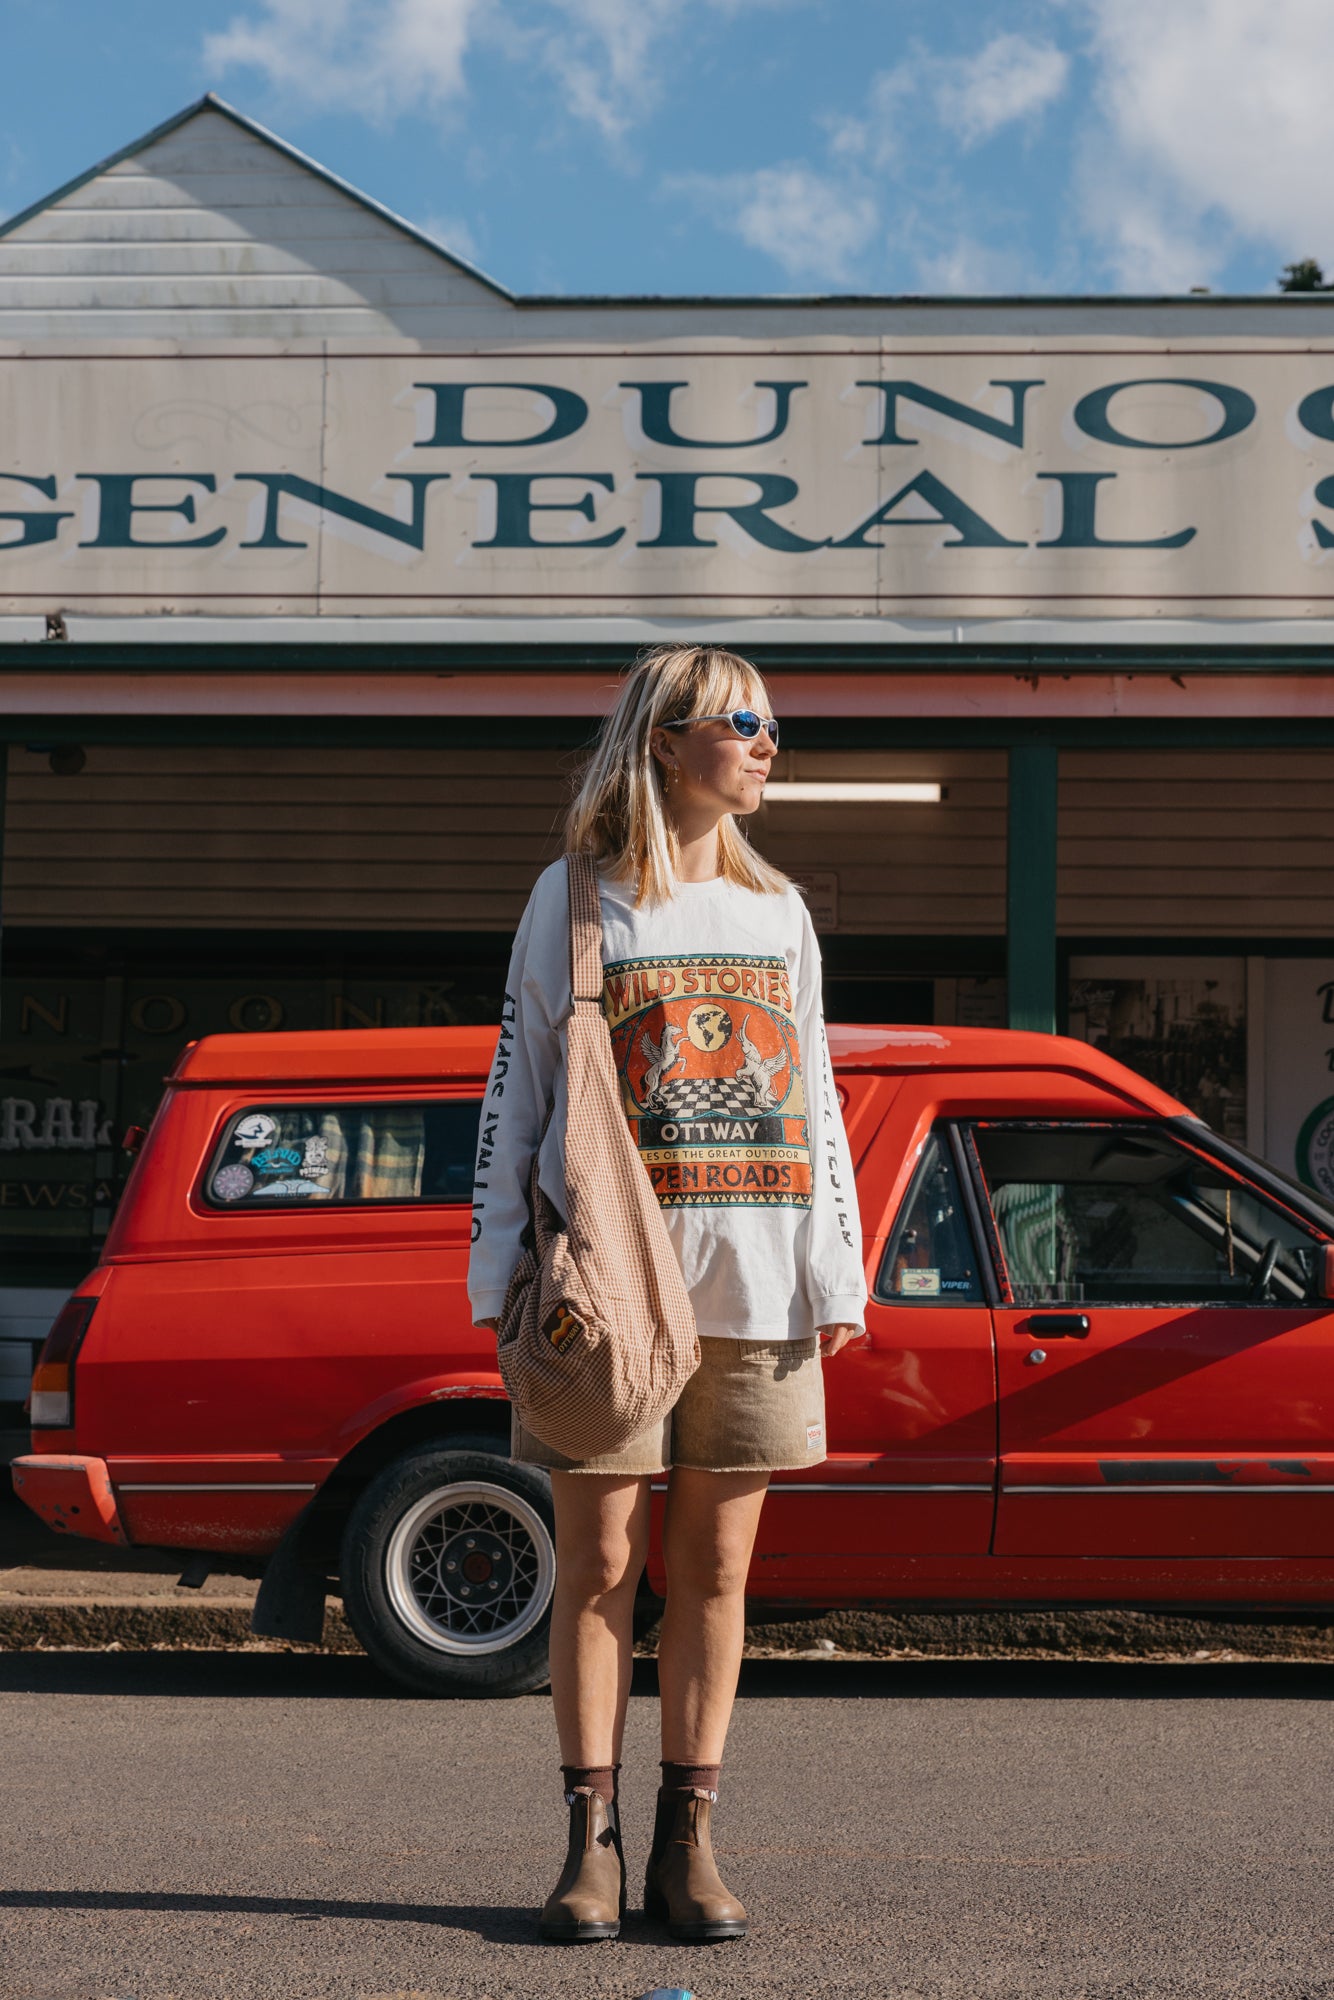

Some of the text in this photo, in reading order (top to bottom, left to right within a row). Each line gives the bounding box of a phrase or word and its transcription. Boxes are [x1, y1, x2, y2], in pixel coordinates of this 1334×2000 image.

[413, 378, 1334, 449] DUNO
[605, 968, 792, 1017] WILD STORIES
[660, 1121, 760, 1142] OTTWAY
[663, 1151, 678, 1160] OF
[682, 1150, 704, 1159] THE
[707, 1149, 741, 1158] GREAT
[745, 1149, 799, 1160] OUTDOOR
[706, 1164, 792, 1188] ROADS
[941, 1280, 971, 1290] VIPER
[558, 1322, 580, 1353] OTTWAY
